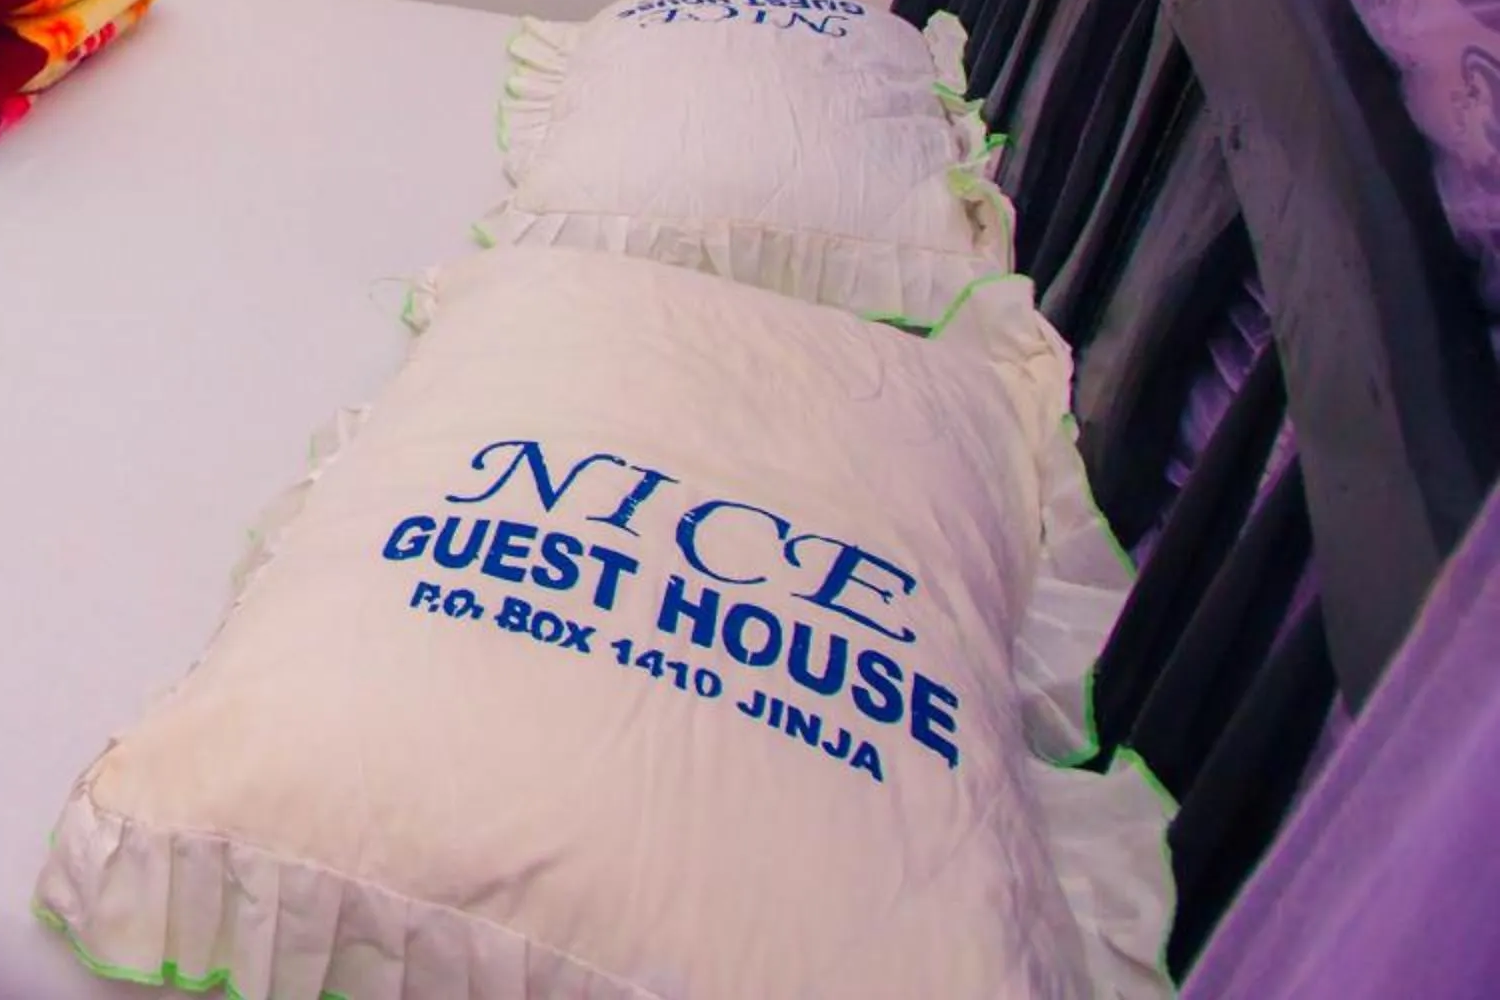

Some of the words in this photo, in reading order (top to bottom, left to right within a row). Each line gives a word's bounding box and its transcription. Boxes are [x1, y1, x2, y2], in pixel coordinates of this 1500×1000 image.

[382, 515, 639, 612] GUEST
[657, 574, 959, 770] HOUSE
[445, 440, 917, 643] NICE
[494, 595, 596, 654] BOX
[611, 638, 722, 698] 1410
[736, 691, 885, 783] JINJA
